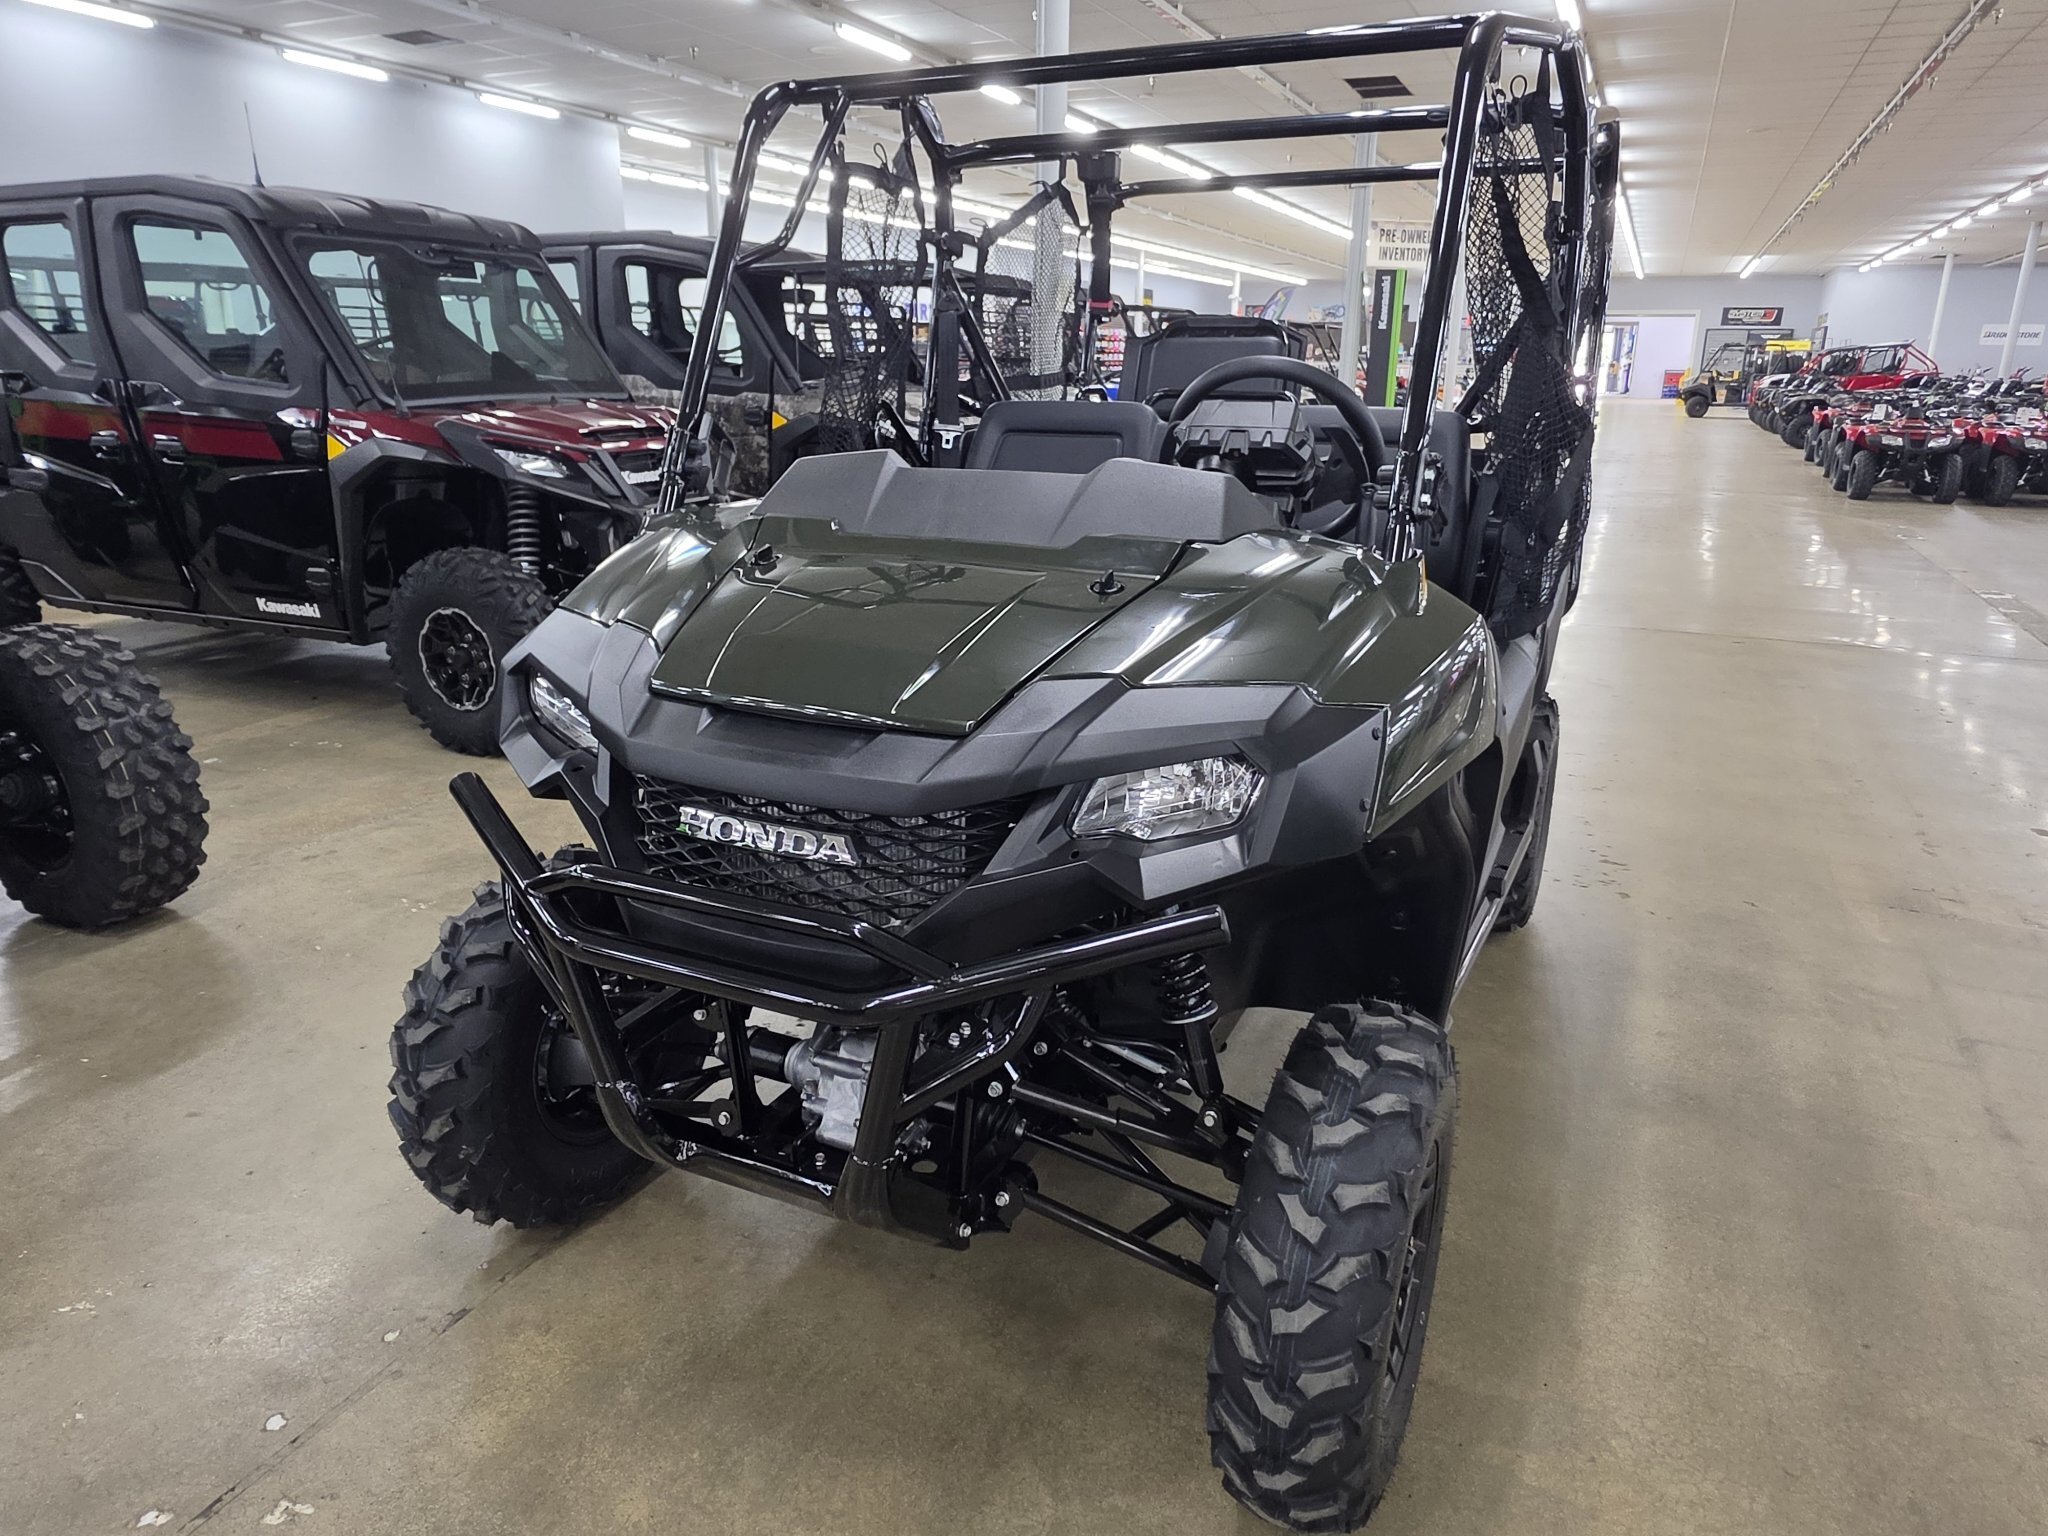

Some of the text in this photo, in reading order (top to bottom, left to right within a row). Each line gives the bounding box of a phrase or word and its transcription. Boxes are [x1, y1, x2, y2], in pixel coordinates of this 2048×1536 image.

[1379, 246, 1429, 262] INVENTORY
[256, 597, 321, 618] Kawasaki
[677, 805, 857, 867] HONDA
